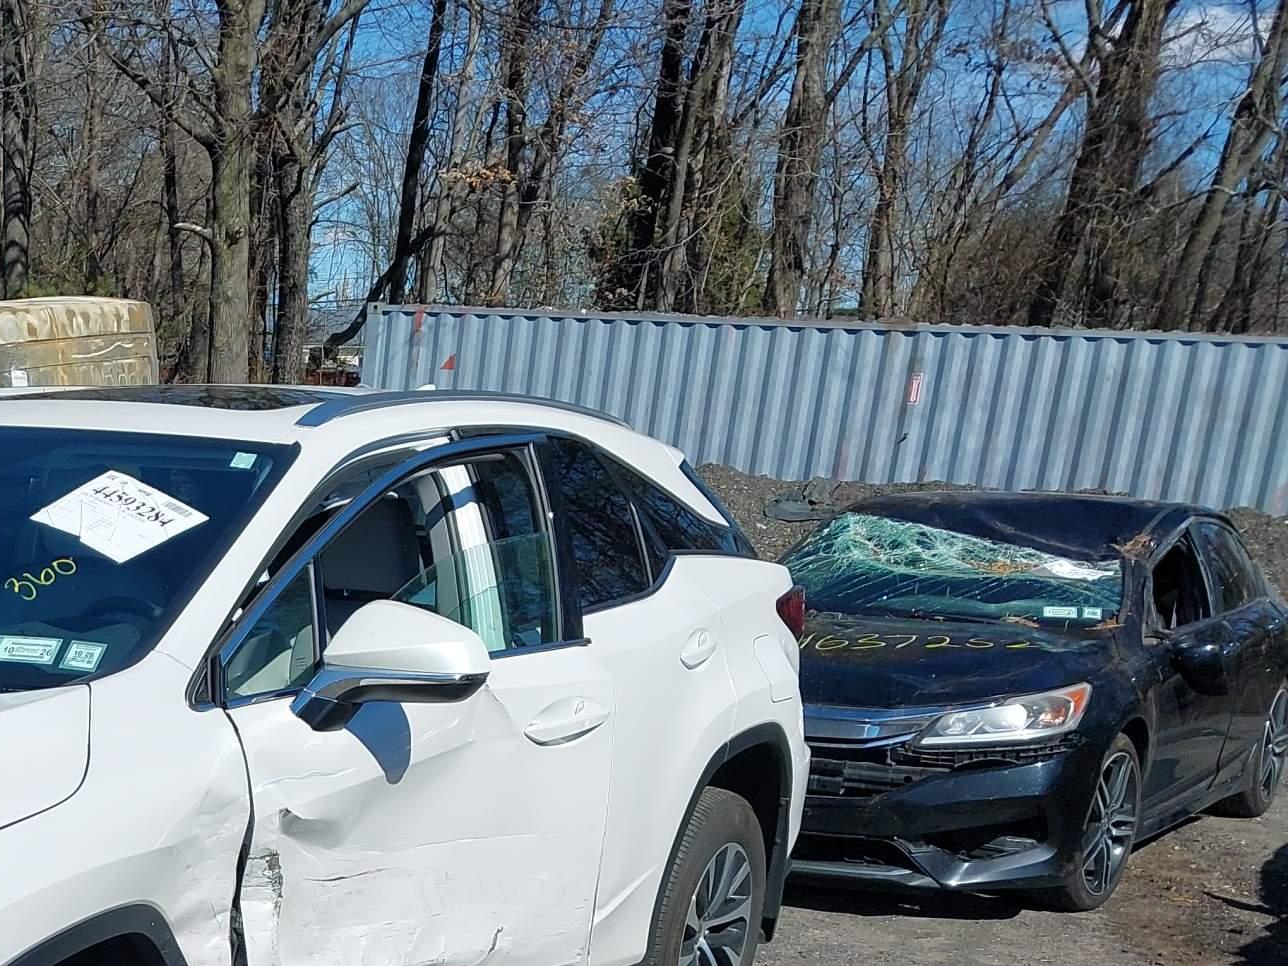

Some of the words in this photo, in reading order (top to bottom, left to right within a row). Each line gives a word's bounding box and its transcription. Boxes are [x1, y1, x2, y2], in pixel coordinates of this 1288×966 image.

[93, 486, 176, 528] 44593284
[4, 557, 76, 600] 360
[3, 646, 15, 654] 10
[39, 648, 53, 656] 26
